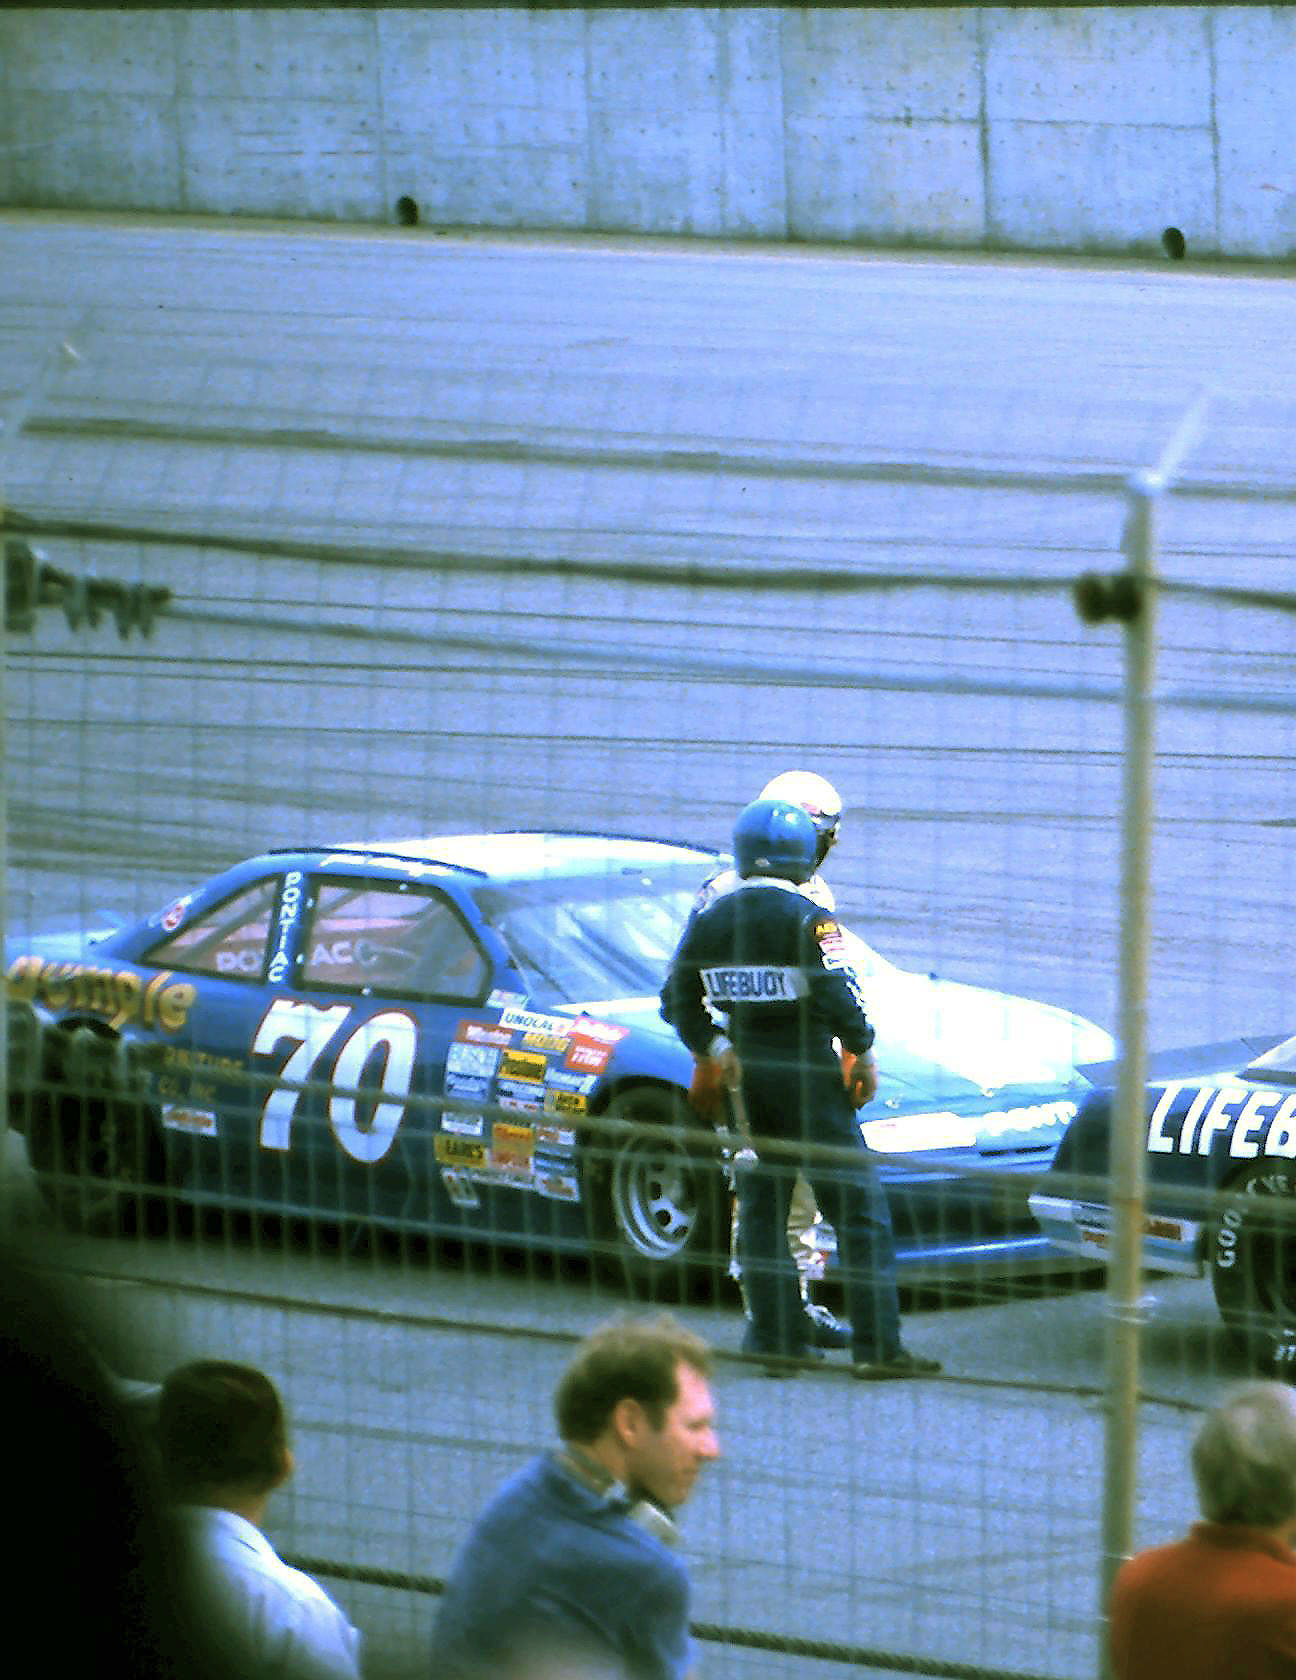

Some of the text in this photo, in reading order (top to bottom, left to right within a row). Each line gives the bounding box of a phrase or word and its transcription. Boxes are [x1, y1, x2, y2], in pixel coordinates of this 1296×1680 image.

[267, 871, 304, 984] PONTIAC
[706, 970, 786, 997] LIFEBUOY
[505, 1012, 554, 1032] UNOCAL
[252, 998, 419, 1164] 70
